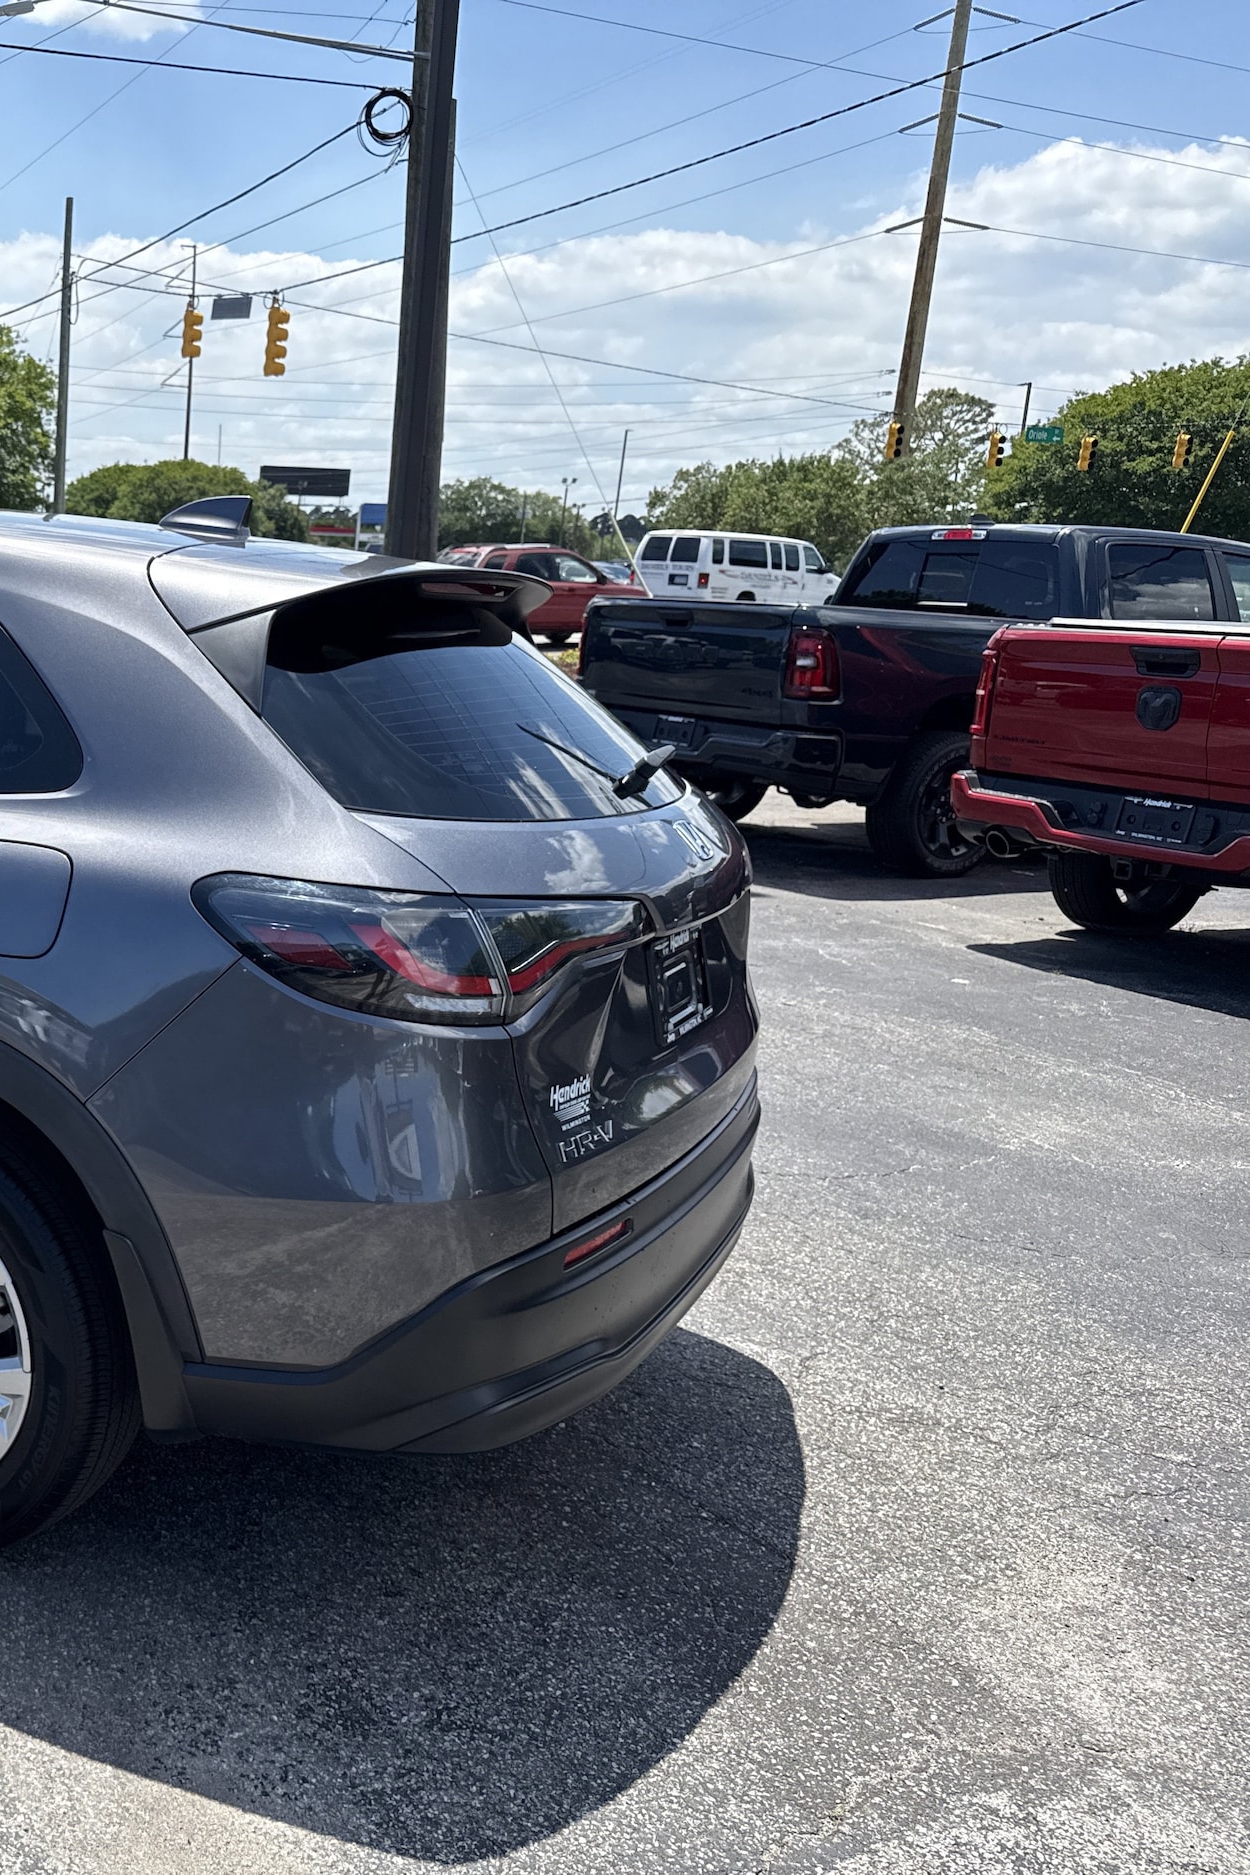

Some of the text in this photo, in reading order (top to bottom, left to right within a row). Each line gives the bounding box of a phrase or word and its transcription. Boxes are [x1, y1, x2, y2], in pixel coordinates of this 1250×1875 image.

[1028, 429, 1048, 440] Oriole
[1143, 798, 1172, 808] Hendrick
[549, 1073, 591, 1111] Hendrick
[561, 1114, 591, 1131] WILMINGTON
[559, 1119, 613, 1162] HR-V
